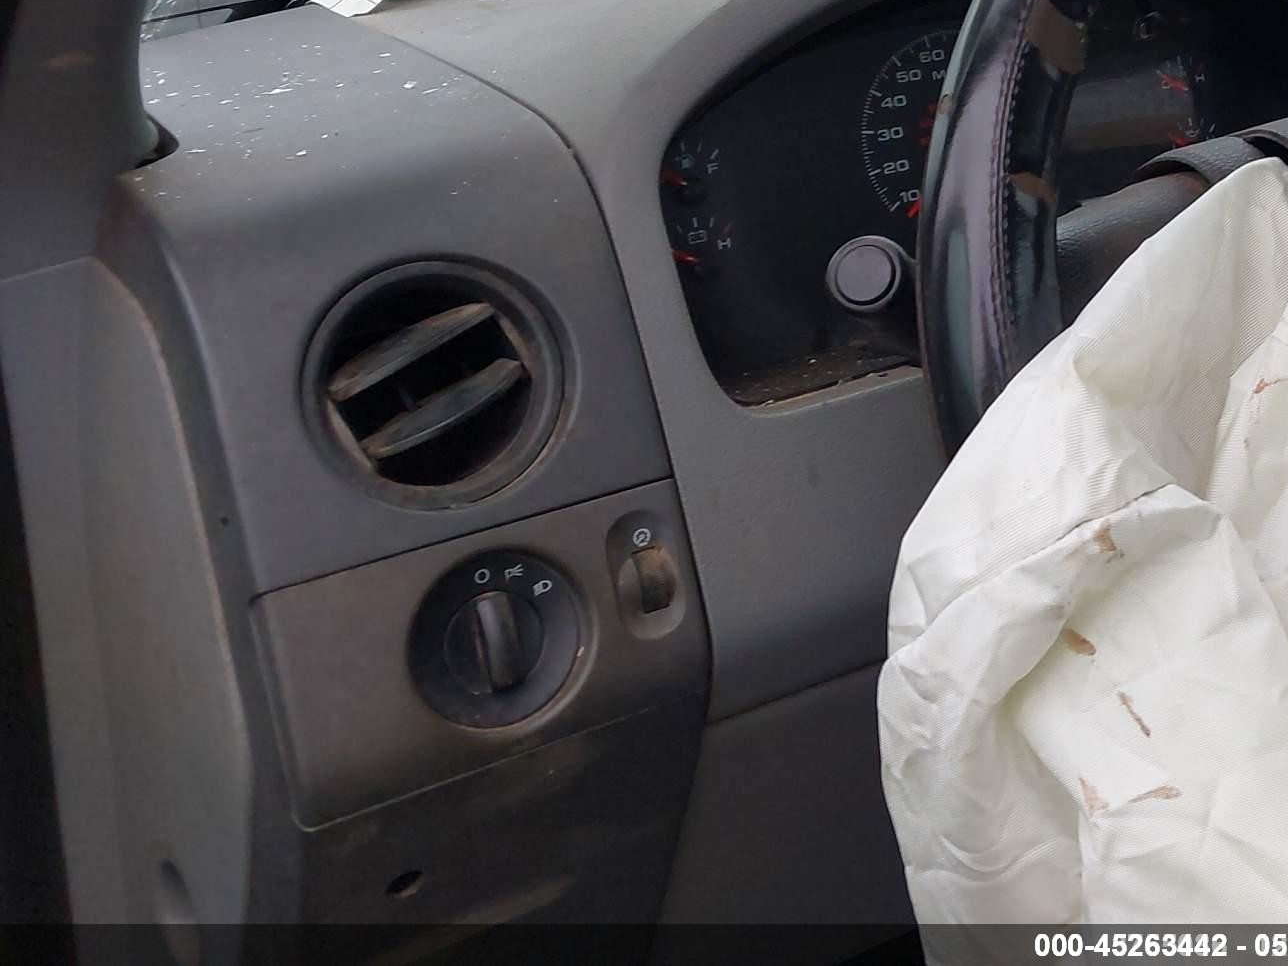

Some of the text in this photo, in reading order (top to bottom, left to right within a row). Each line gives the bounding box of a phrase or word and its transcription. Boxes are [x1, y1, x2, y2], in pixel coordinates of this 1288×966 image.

[919, 49, 945, 63] 60
[896, 69, 922, 83] 50
[881, 94, 907, 108] 40
[877, 126, 904, 141] 30
[707, 162, 720, 175] F
[883, 159, 910, 174] 20
[899, 188, 921, 202] 10
[717, 237, 731, 250] H
